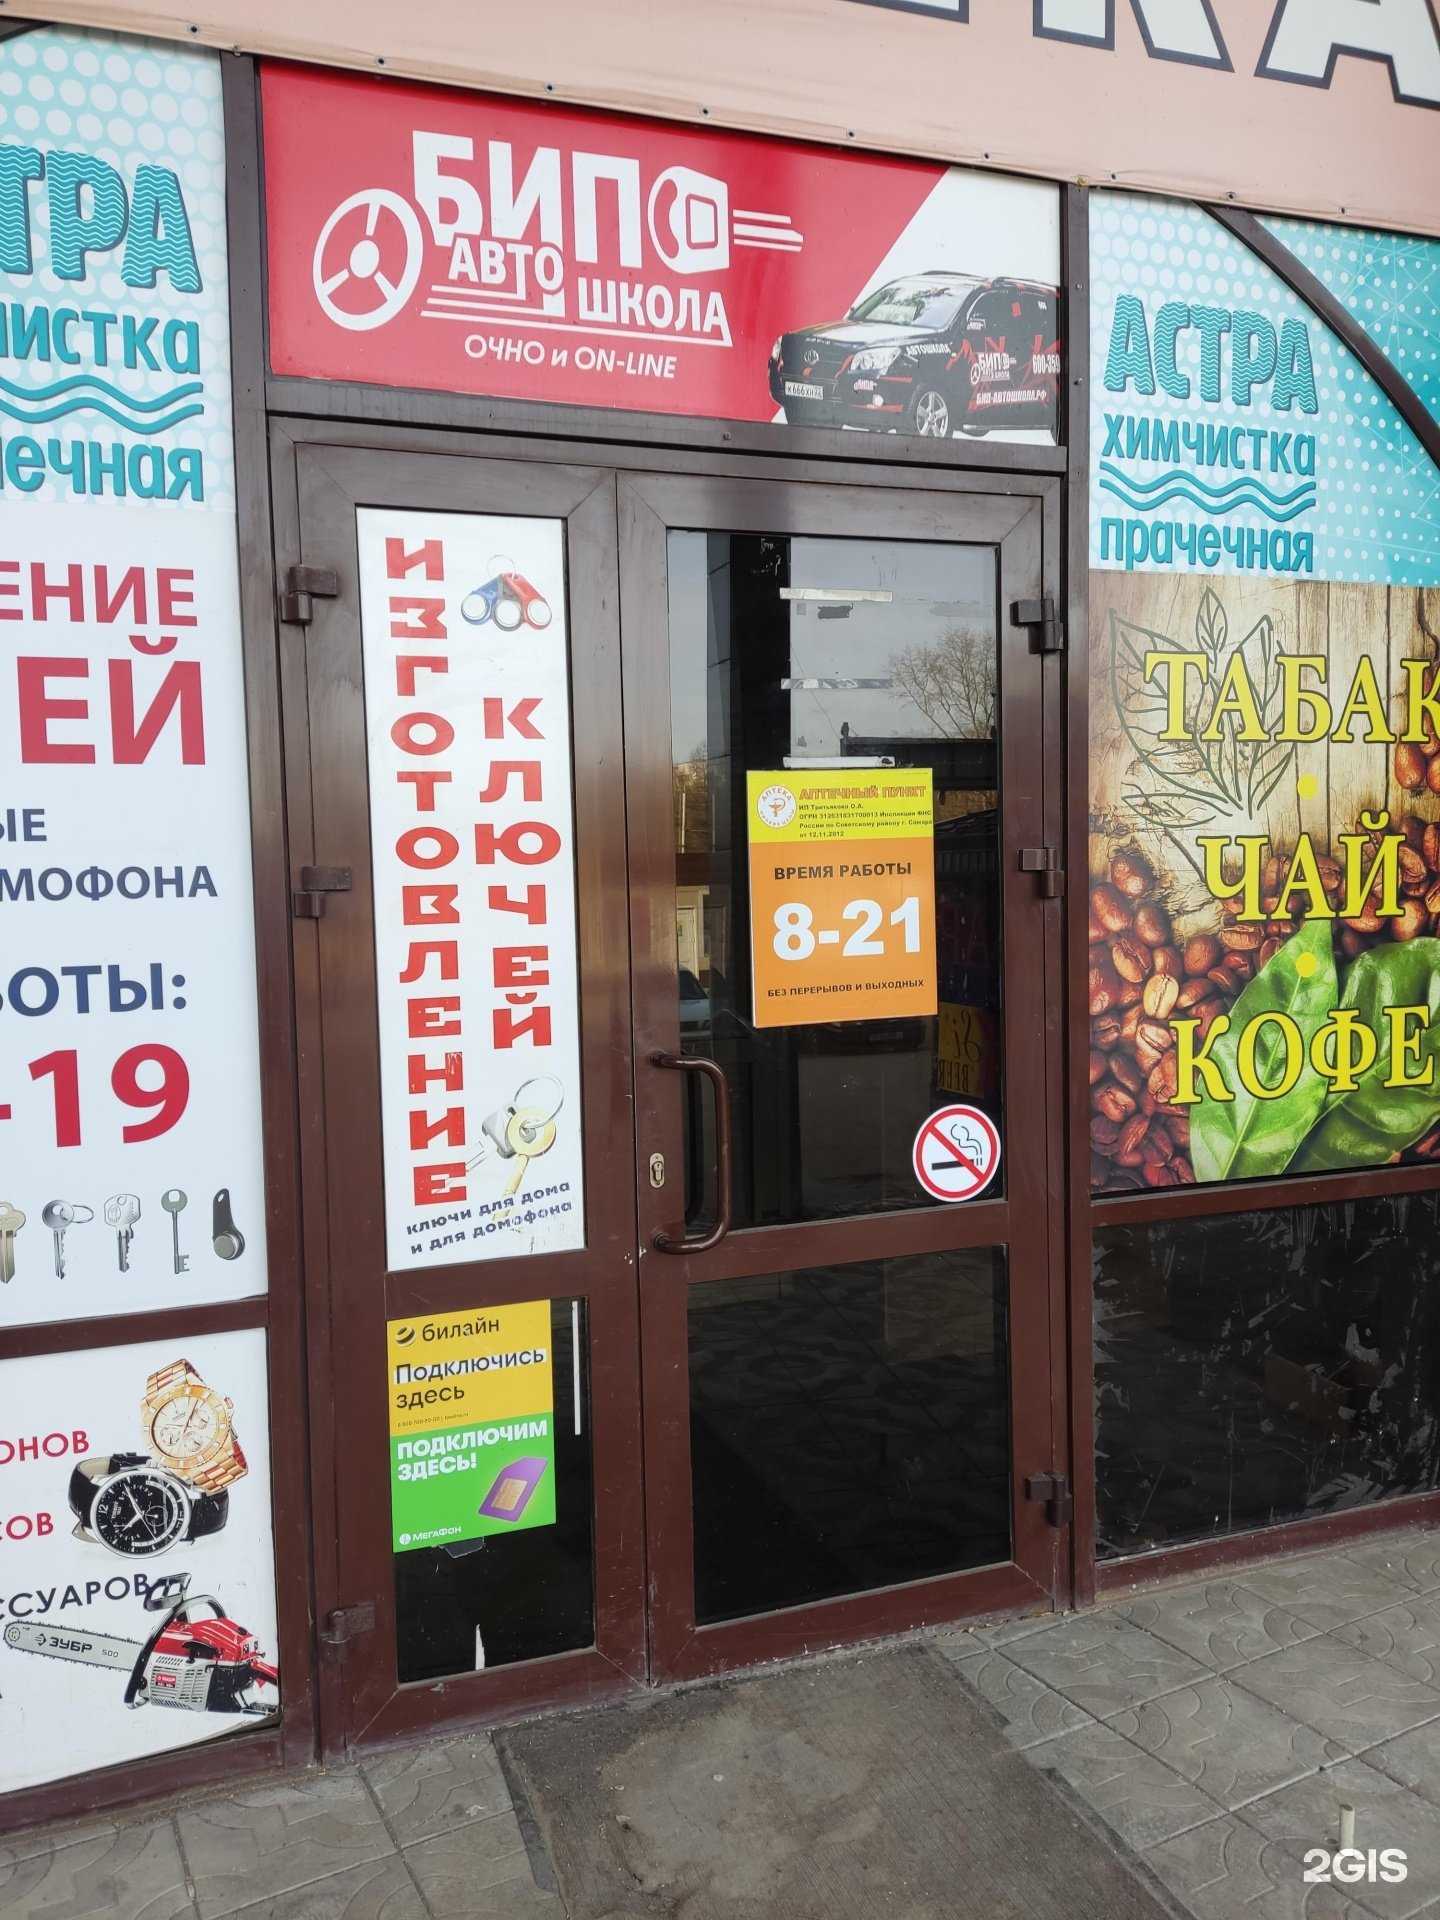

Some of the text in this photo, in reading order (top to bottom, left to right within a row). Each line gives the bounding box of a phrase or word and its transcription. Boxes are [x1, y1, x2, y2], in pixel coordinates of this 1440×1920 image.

[448, 238, 564, 298] АВТО
[578, 277, 730, 340] ШКОЛА
[0, 302, 201, 375] истка
[465, 334, 545, 366] ОЧНО
[575, 346, 678, 379] ON-LINE
[1103, 294, 1319, 414] АСТРА
[0, 435, 204, 502] ечная
[1102, 412, 1316, 476] химчистка
[1100, 517, 1314, 573] прачечная
[17, 634, 206, 765] ЕЙ
[1143, 650, 1440, 743] ТАБАК
[882, 785, 926, 798] ПУНКТ
[385, 537, 468, 1206] ИЗГОТОВЛЕНИЕ
[473, 697, 561, 1049] КЛЮЧЕЙ
[774, 862, 912, 880] ВРЕМЯ РАБОТЫ
[1196, 810, 1407, 922] ЧАЙ
[773, 896, 921, 961] 8-21
[0, 962, 187, 1017] ОТЫ:
[767, 978, 925, 997] БЕЗ ПЕРЕРЫВОВ И ВЫХОДНЫХ
[1168, 1004, 1434, 1105] КОФЕ
[479, 1197, 515, 1217] для
[521, 1181, 571, 1205] дома
[429, 1231, 466, 1251] для
[421, 1317, 500, 1342] билайн
[396, 1348, 545, 1384] Подключись
[396, 1385, 465, 1411] здесь
[397, 1420, 548, 1460] ПОДКЛЮЧИМ
[397, 1452, 478, 1482] ЗДЕСЬ!
[0, 1512, 54, 1541] ОВ
[0, 1573, 150, 1620] СУАРОВ
[50, 1636, 119, 1658] ЗУБР 500
